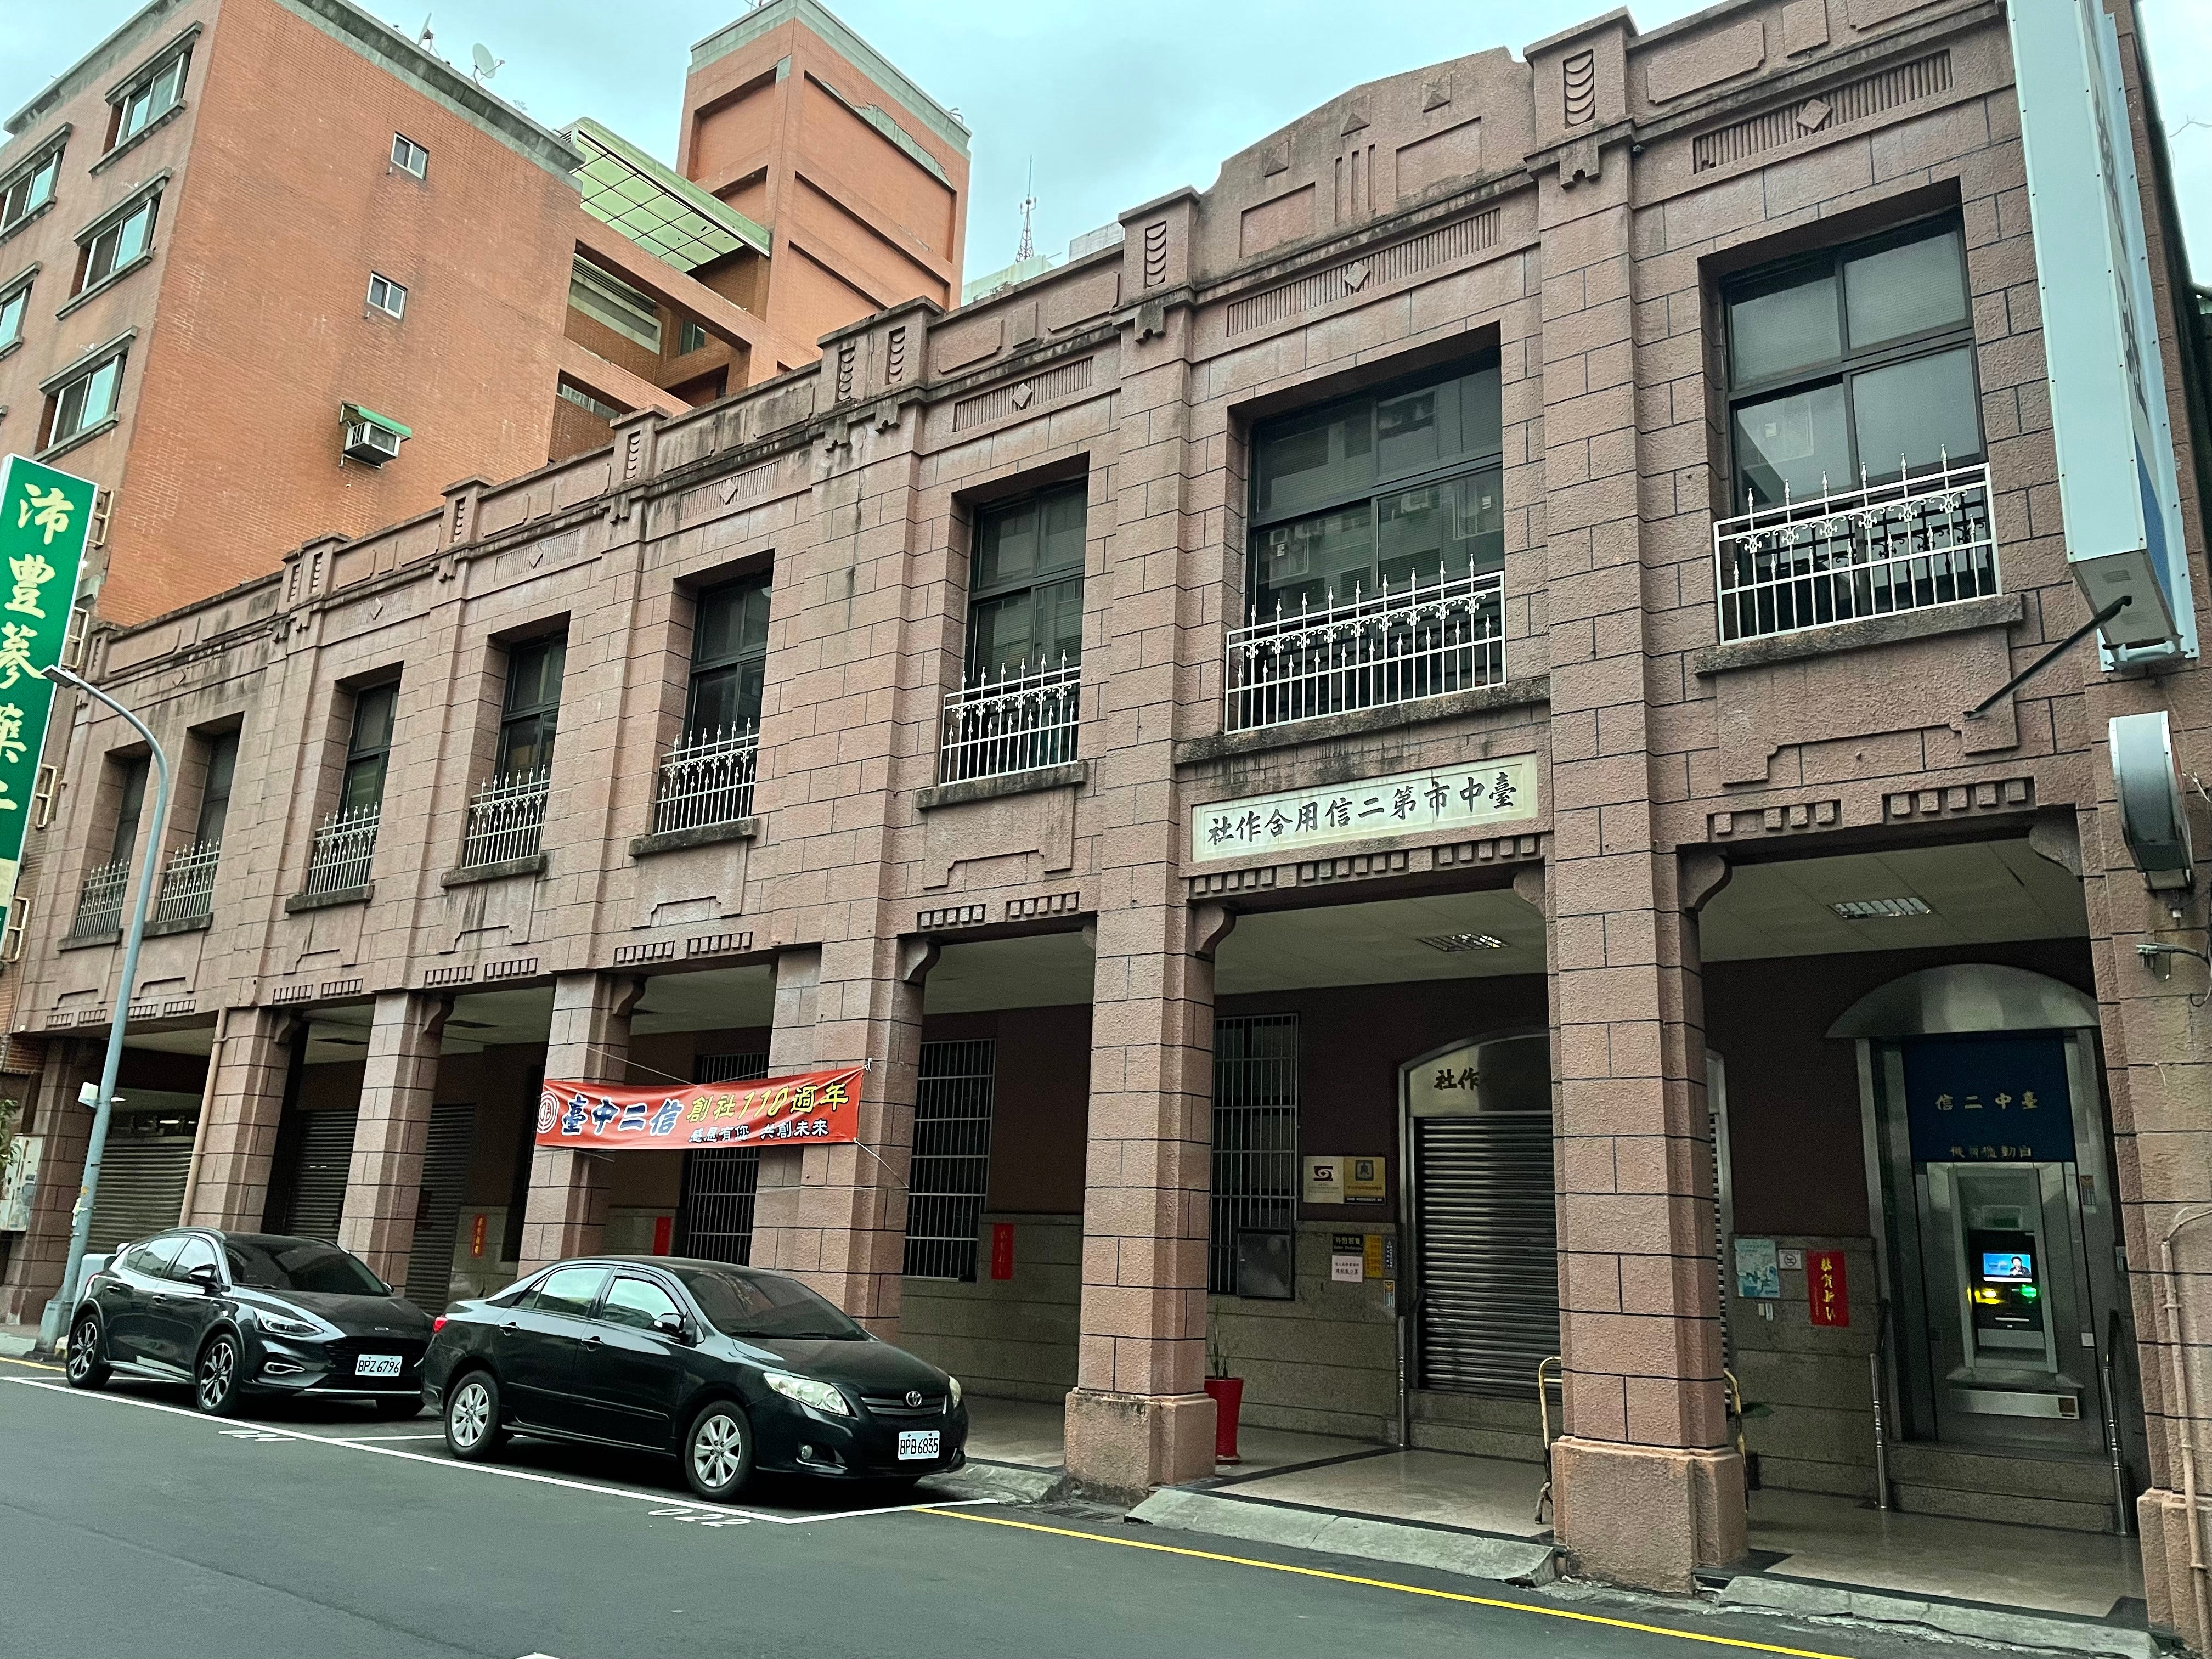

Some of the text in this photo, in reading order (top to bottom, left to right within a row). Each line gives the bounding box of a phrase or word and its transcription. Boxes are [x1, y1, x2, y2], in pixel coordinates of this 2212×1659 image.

[1935, 1090, 2038, 1111] 臺中二信
[561, 1092, 685, 1136] 臺中二信
[688, 1119, 829, 1144] 感恩有您 共創未來
[648, 1508, 752, 1527] 022
